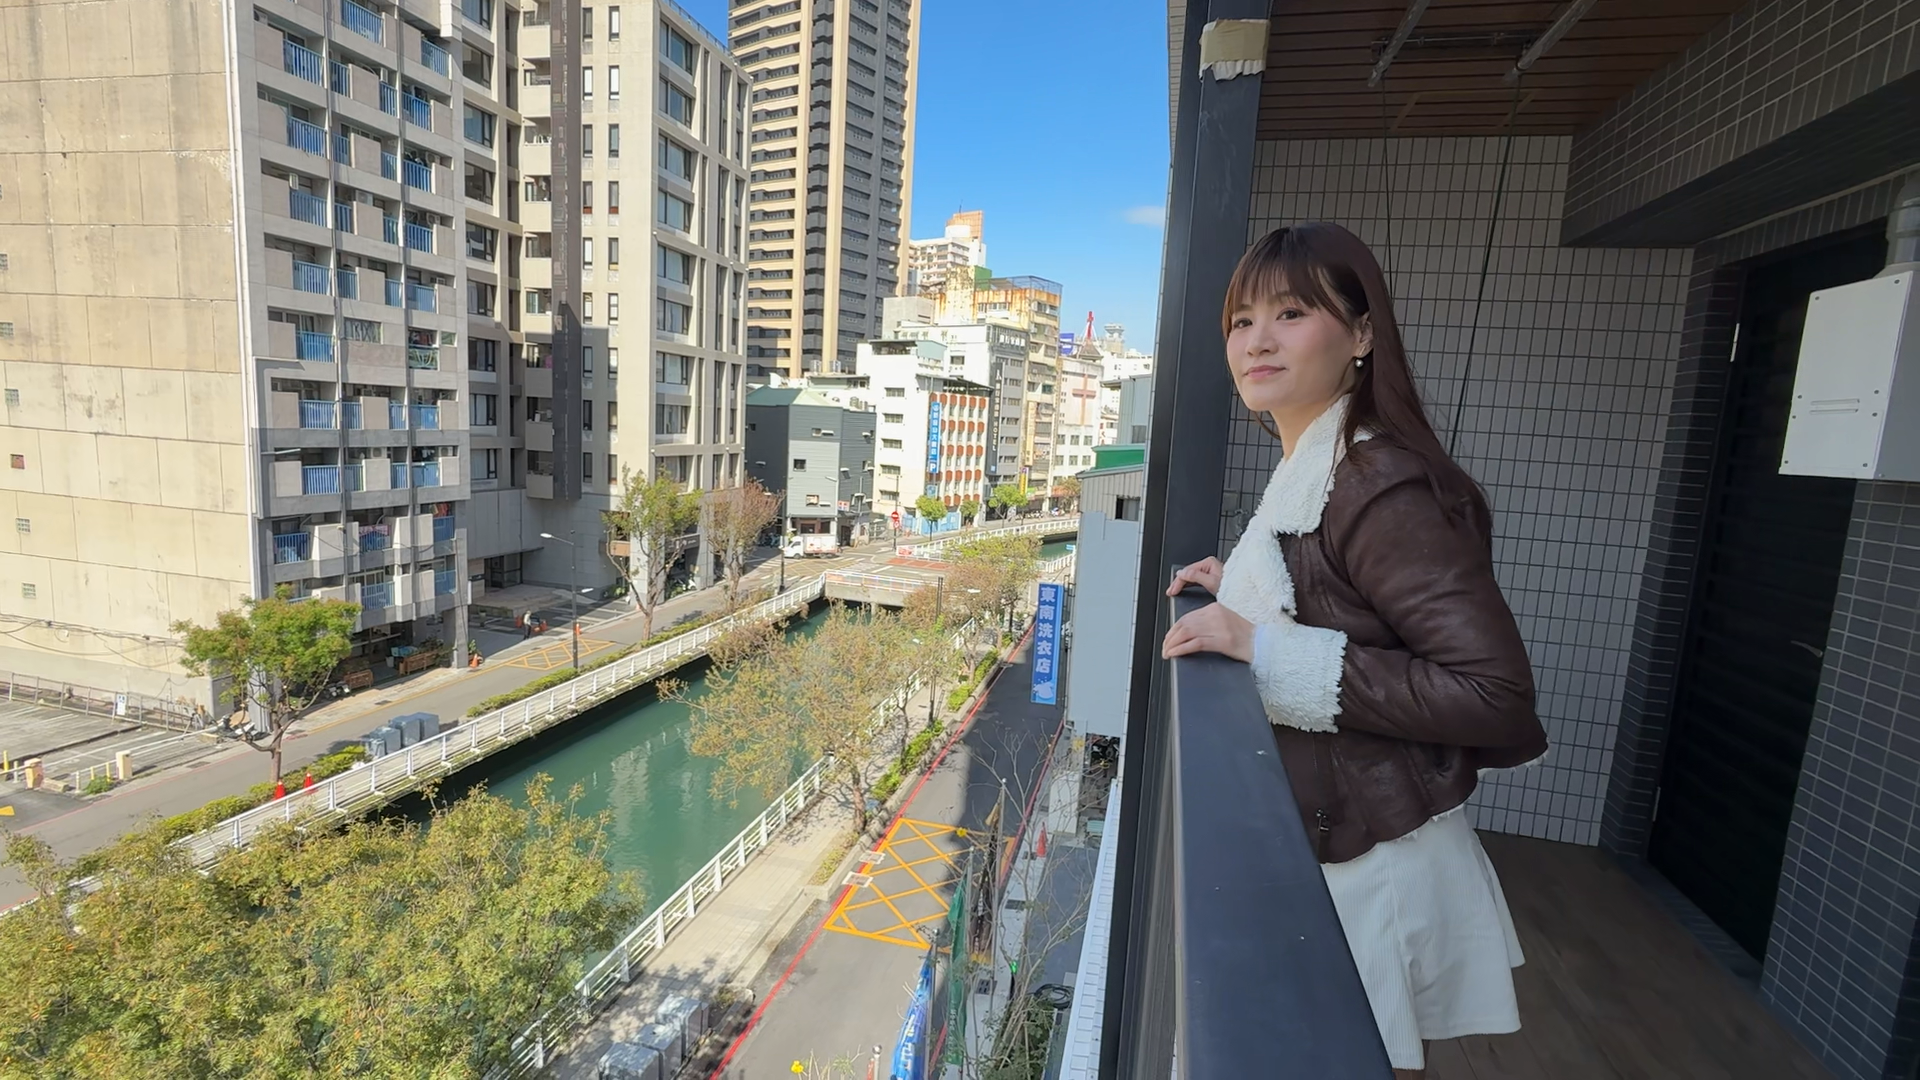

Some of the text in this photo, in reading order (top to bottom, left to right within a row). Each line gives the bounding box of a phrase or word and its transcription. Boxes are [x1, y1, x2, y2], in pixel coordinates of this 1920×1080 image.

[930, 463, 936, 471] P
[1035, 586, 1056, 674] 東南洗衣店
